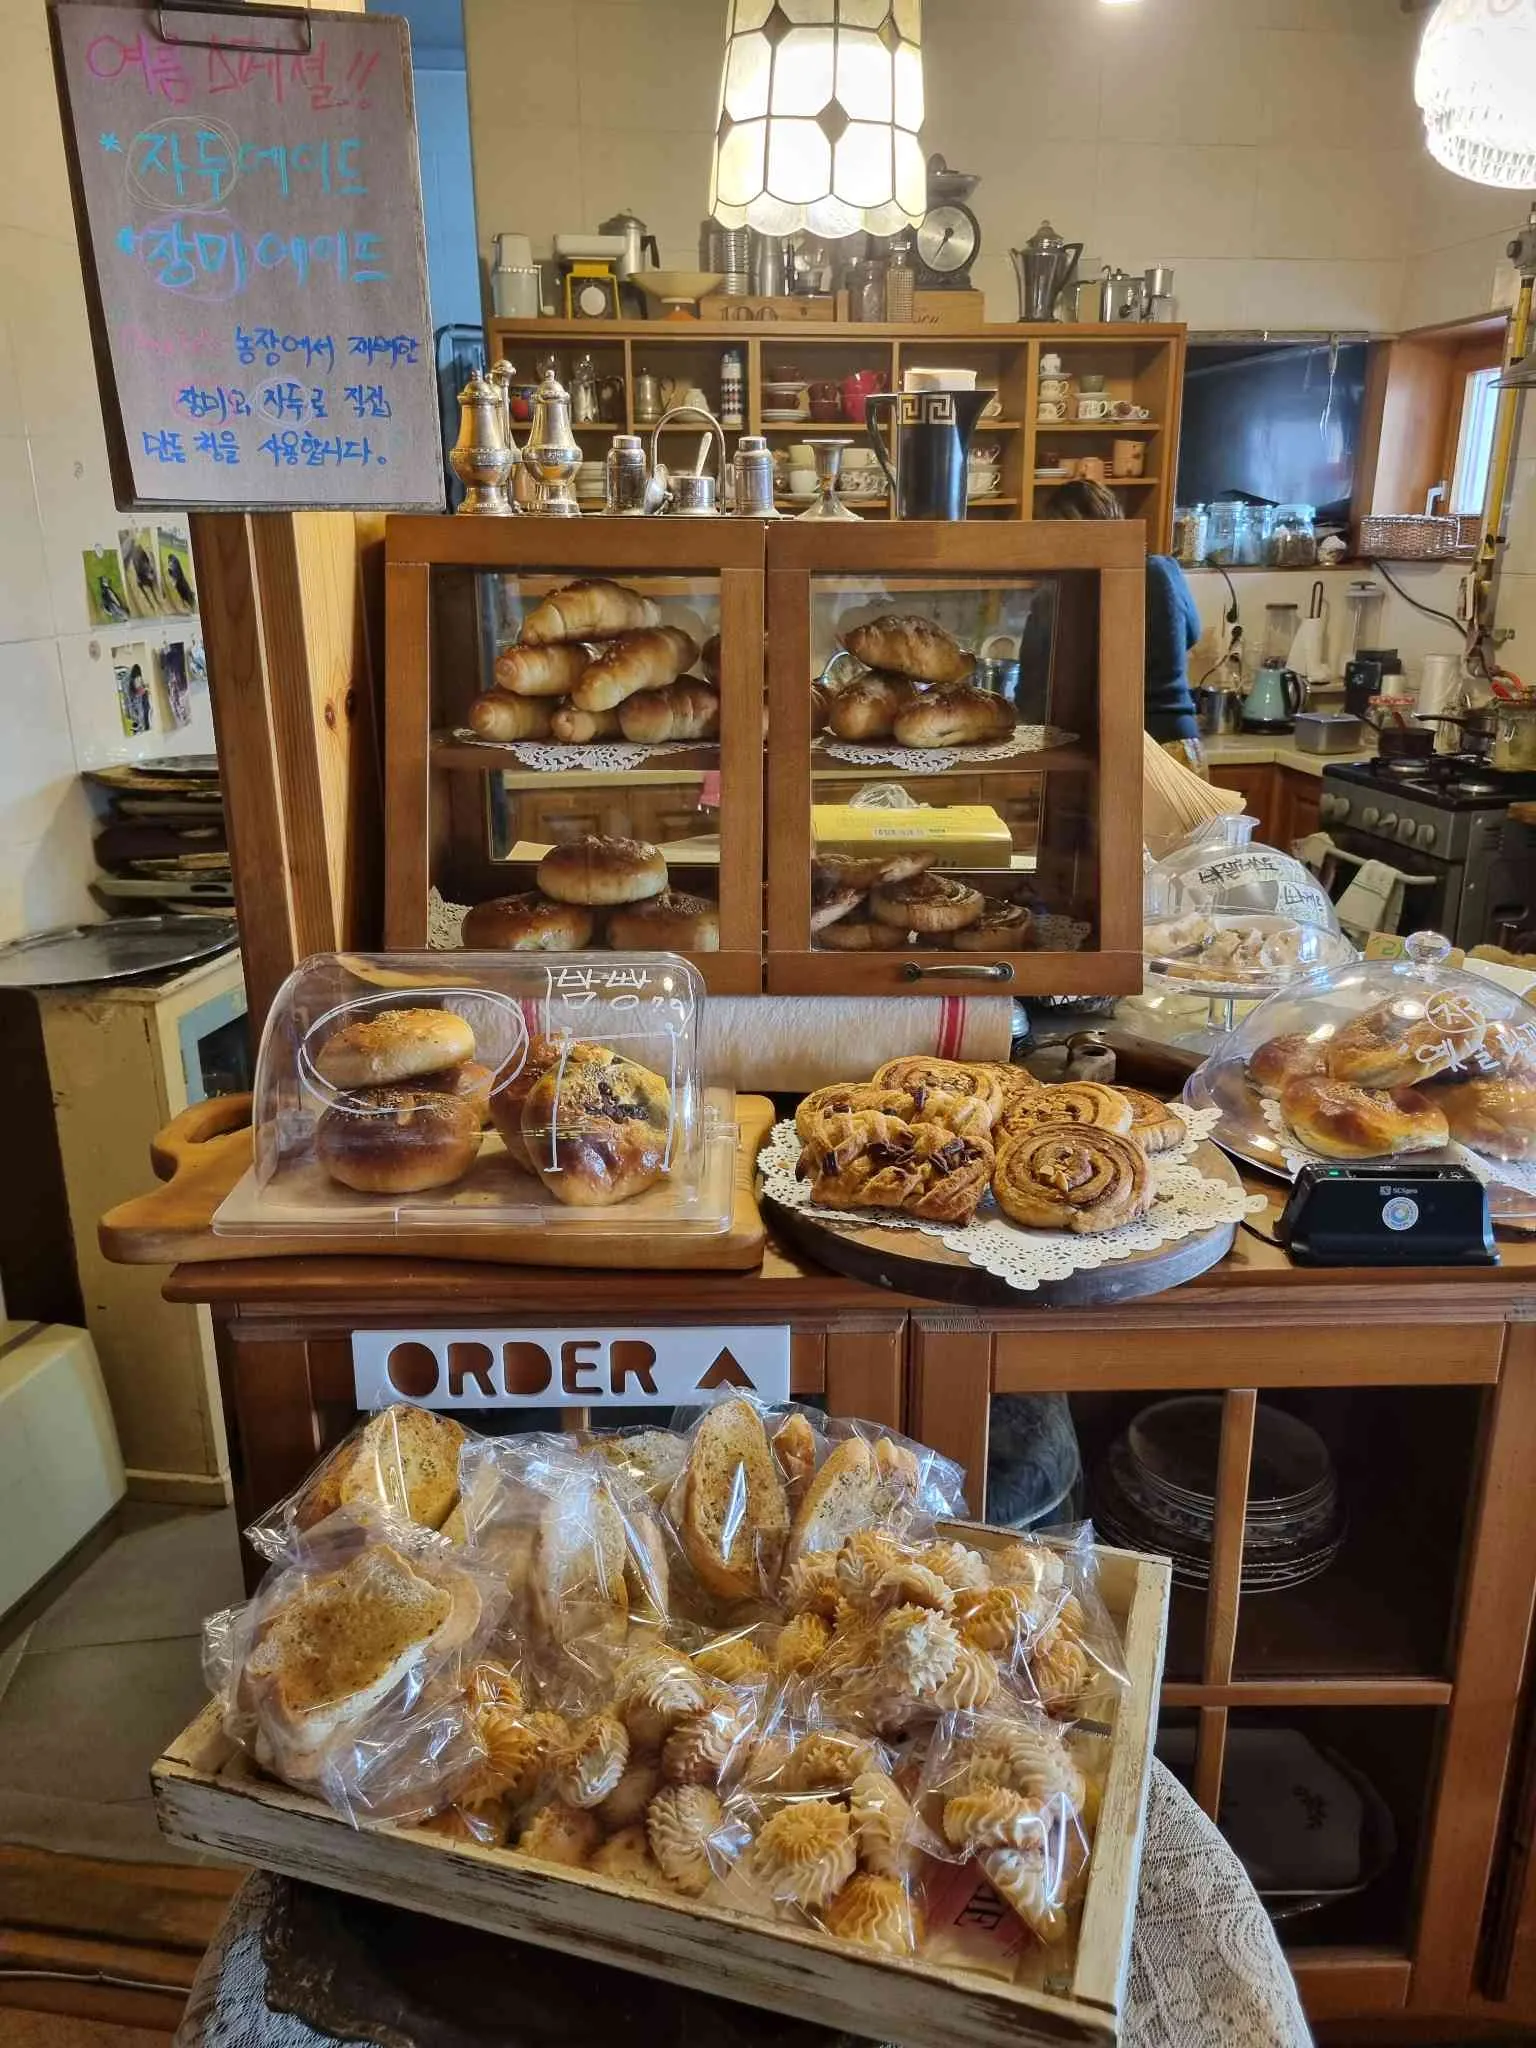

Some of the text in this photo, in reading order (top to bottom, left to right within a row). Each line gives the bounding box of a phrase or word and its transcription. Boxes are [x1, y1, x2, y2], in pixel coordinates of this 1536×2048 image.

[86, 33, 194, 106] 여름
[234, 325, 335, 375] 농장에서
[344, 384, 393, 423] 직접
[257, 430, 388, 467] 사용합니다.
[386, 1340, 660, 1398] ORDER
